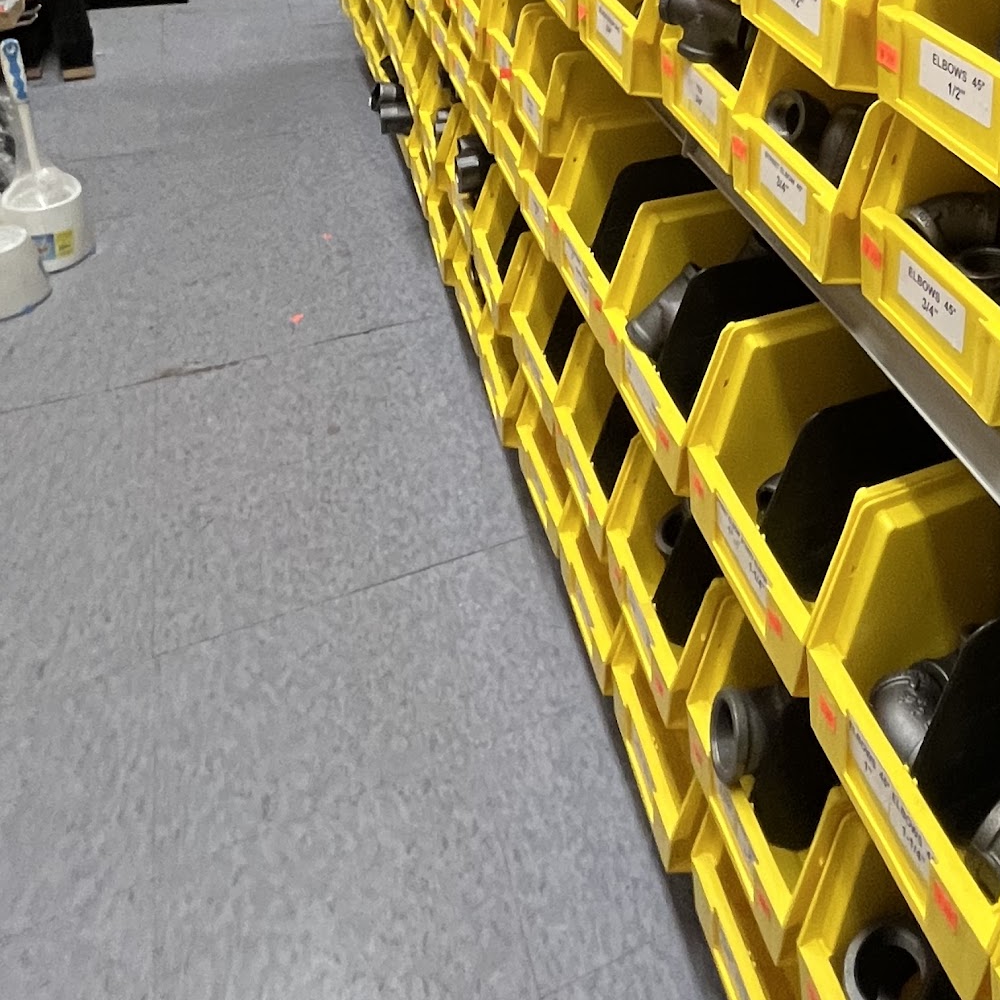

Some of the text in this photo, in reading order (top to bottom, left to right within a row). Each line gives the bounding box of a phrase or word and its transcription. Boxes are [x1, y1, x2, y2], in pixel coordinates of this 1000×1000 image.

[932, 53, 968, 83] ELBOWS
[908, 266, 941, 304] ELBOWS
[921, 297, 939, 318] 3/4"
